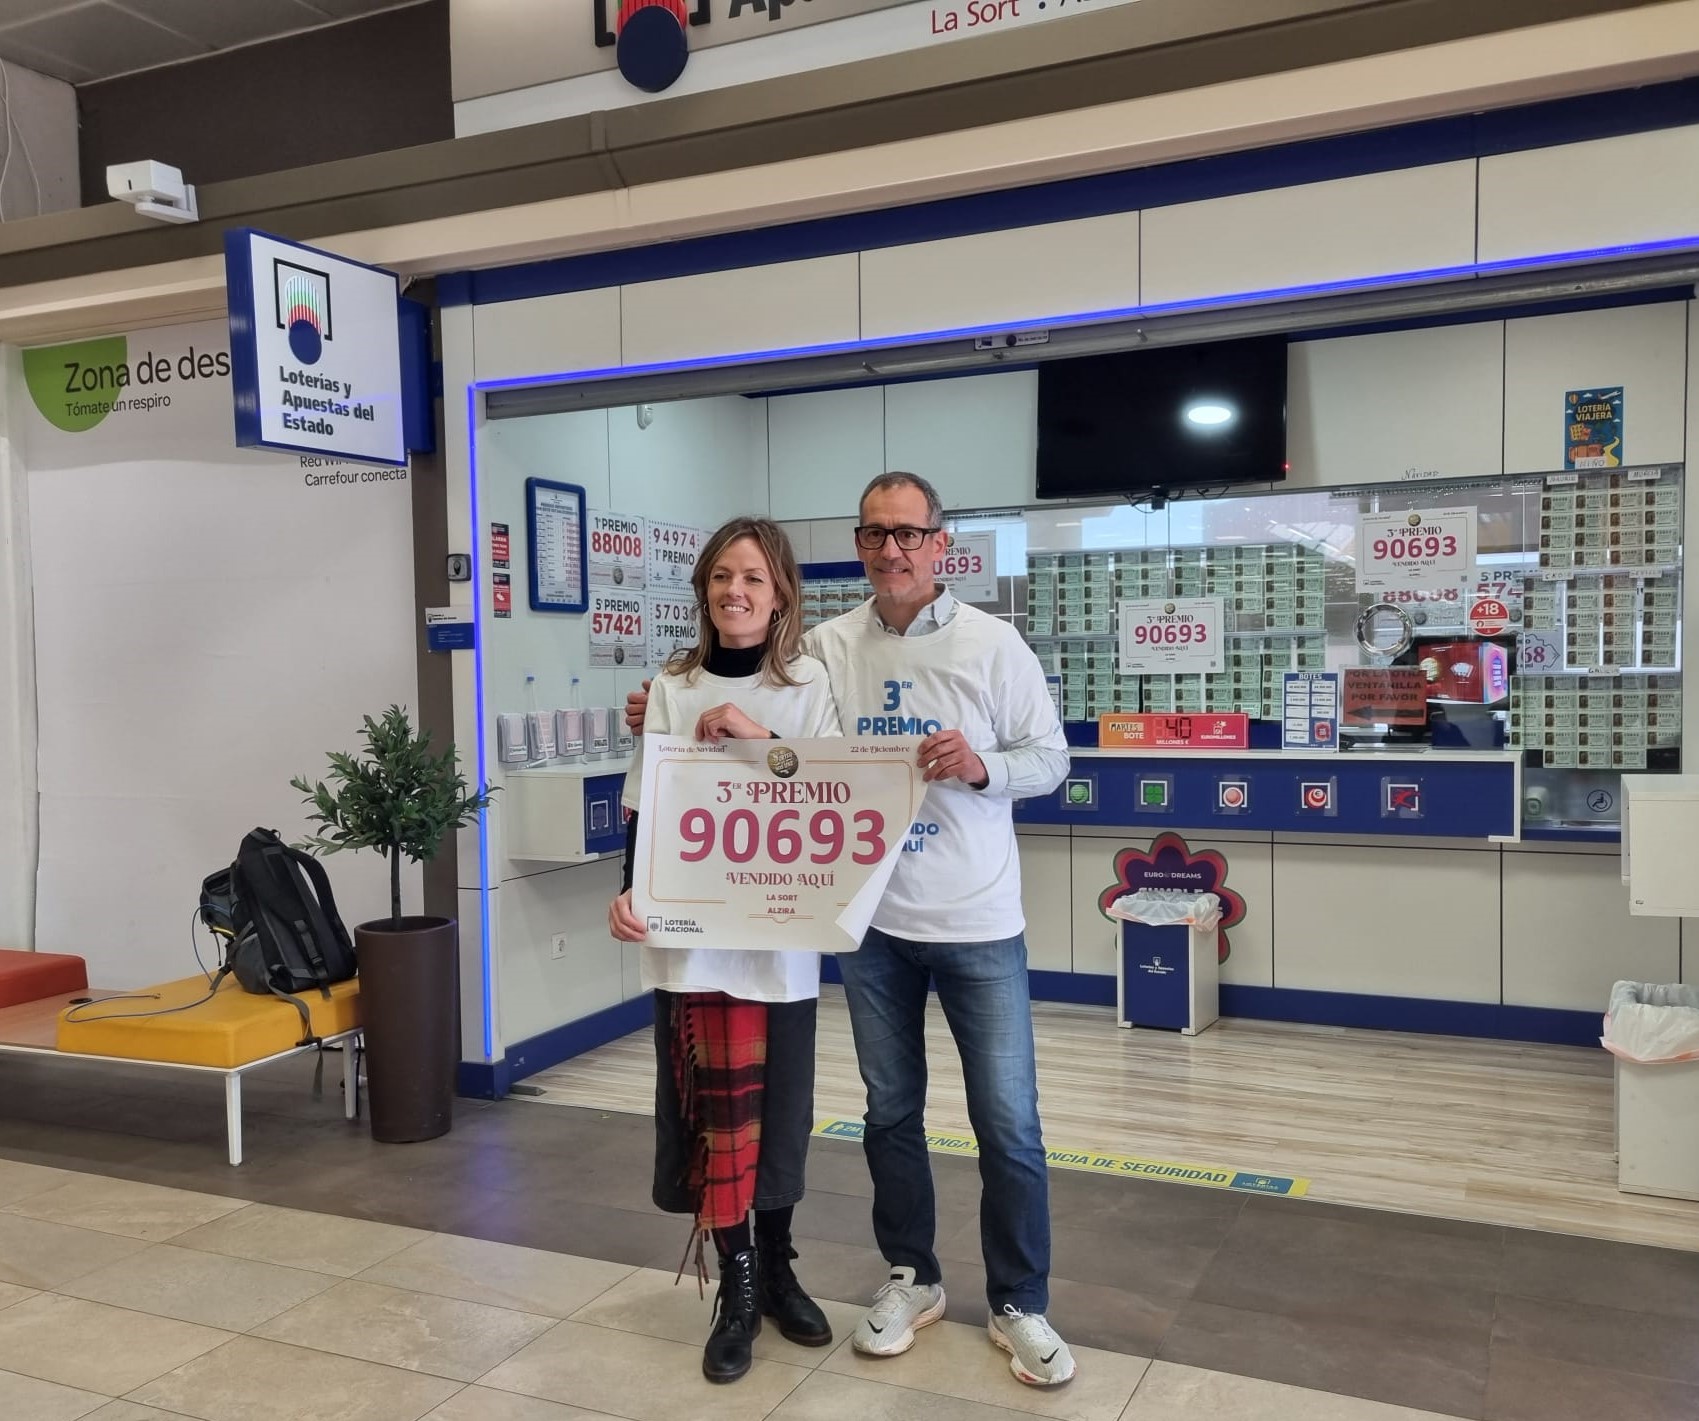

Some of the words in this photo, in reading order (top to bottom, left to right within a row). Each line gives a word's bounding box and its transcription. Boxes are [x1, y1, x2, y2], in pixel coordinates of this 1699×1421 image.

[931, 9, 958, 35] La
[967, 0, 1020, 26] Sort
[64, 360, 131, 393] Zona
[136, 351, 172, 385] de
[177, 346, 231, 381] des
[279, 365, 340, 393] Loterías
[343, 382, 352, 399] y
[66, 401, 111, 417] Tómate
[111, 401, 127, 413] un
[128, 393, 171, 412] respiro
[282, 390, 350, 417] Apuestas
[353, 403, 375, 421] del
[1577, 403, 1612, 413] LOTERÍA
[282, 412, 335, 436] Estado
[1576, 412, 1613, 421] VIAJERA
[304, 471, 360, 487] Carrefour
[360, 469, 407, 482] conecta
[602, 517, 638, 535] PREMIO
[1398, 526, 1442, 537] PREMIO
[591, 531, 643, 558] 88008
[653, 527, 696, 549] 94974
[1373, 536, 1457, 560] 90693
[662, 549, 696, 566] PREMIO
[604, 599, 640, 613] PREMIO
[1476, 603, 1500, 615] +18
[592, 612, 642, 636] 57421
[1156, 614, 1194, 624] PREMIO
[664, 624, 696, 639] PREMIO
[1134, 623, 1207, 645] 90693
[1298, 673, 1323, 681] BOTES
[1348, 681, 1421, 690] VENTANILLA
[1351, 693, 1377, 701] POR
[1379, 693, 1418, 701] FAVOR
[857, 715, 943, 737] PREMIO
[1123, 732, 1145, 740] BOTE
[1155, 738, 1184, 746] MILLONES
[859, 745, 869, 753] de
[869, 745, 911, 754] Diciembre
[746, 781, 852, 804] PREMIO
[679, 808, 887, 865] 90693
[726, 871, 793, 886] VENDIDO
[796, 870, 835, 889] AQUÍ
[766, 894, 777, 902] LA
[778, 894, 798, 902] SORT
[767, 907, 796, 915] ALZIRA
[664, 918, 697, 927] LOTERÍA
[664, 926, 704, 934] NACIONAL
[1092, 1158, 1120, 1168] DE
[1120, 1159, 1228, 1183] SEGURIDAD
